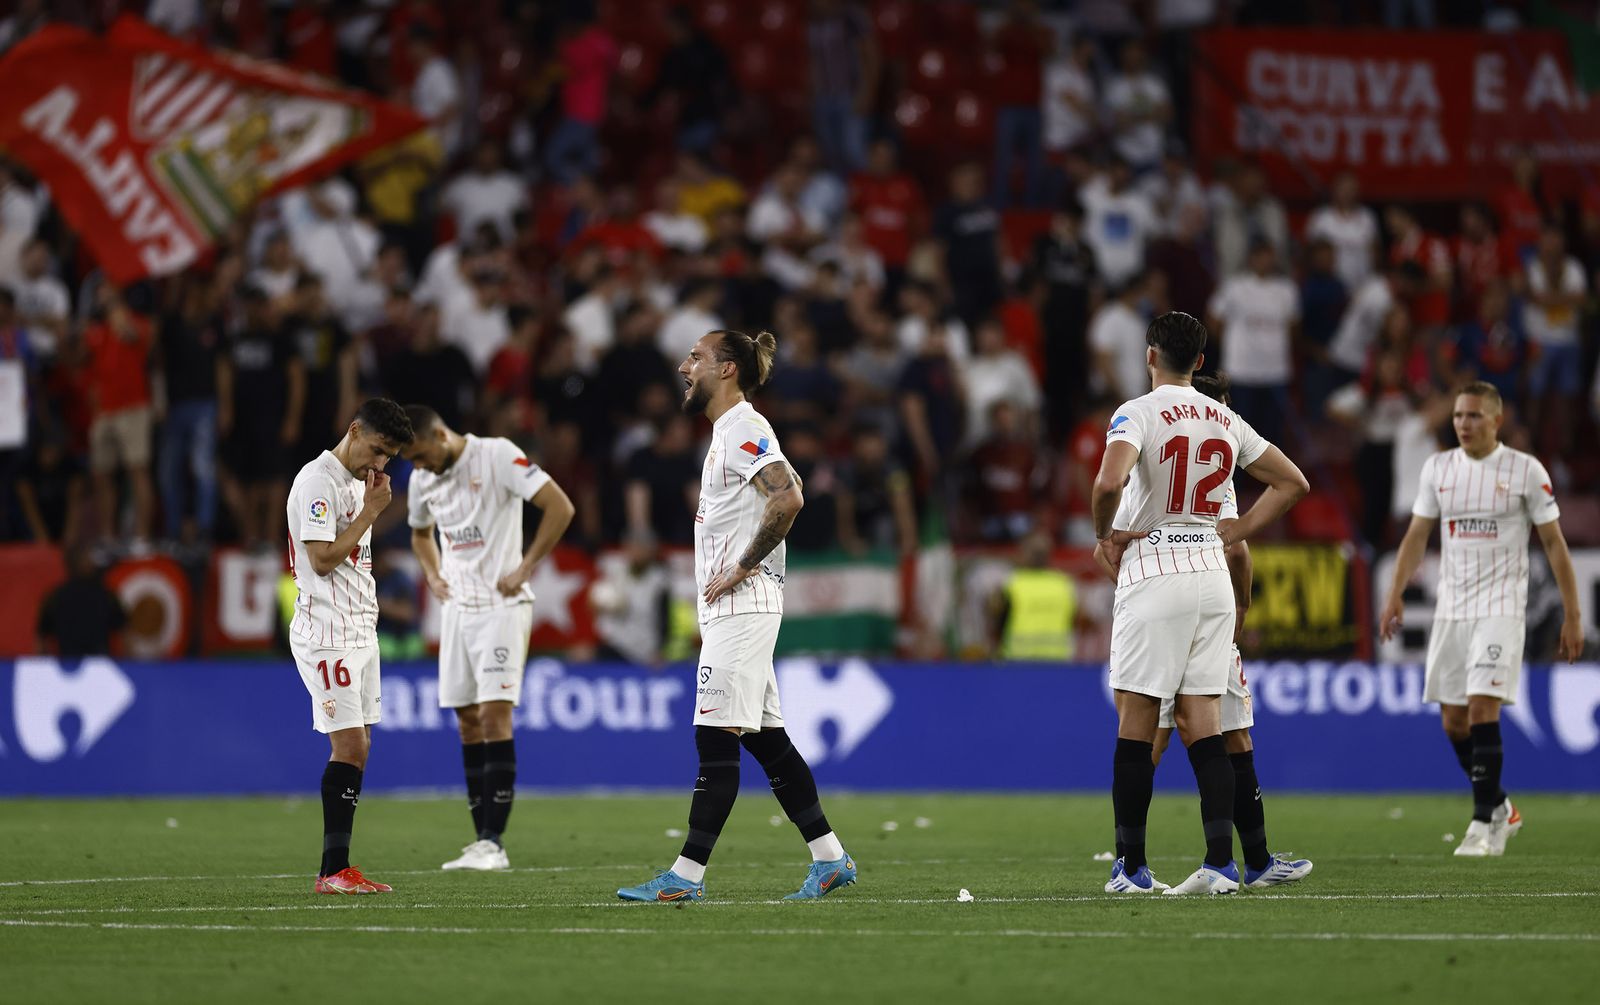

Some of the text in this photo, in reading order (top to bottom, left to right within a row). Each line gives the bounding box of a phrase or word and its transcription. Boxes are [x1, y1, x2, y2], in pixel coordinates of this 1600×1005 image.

[1246, 48, 1442, 110] CURVA
[1473, 52, 1507, 112] E
[1160, 404, 1232, 431] RAFA MIR
[1159, 435, 1233, 517] 12
[1167, 534, 1217, 543] SOCIOS.CO
[1458, 519, 1498, 531] NAGA
[316, 658, 351, 691] 16
